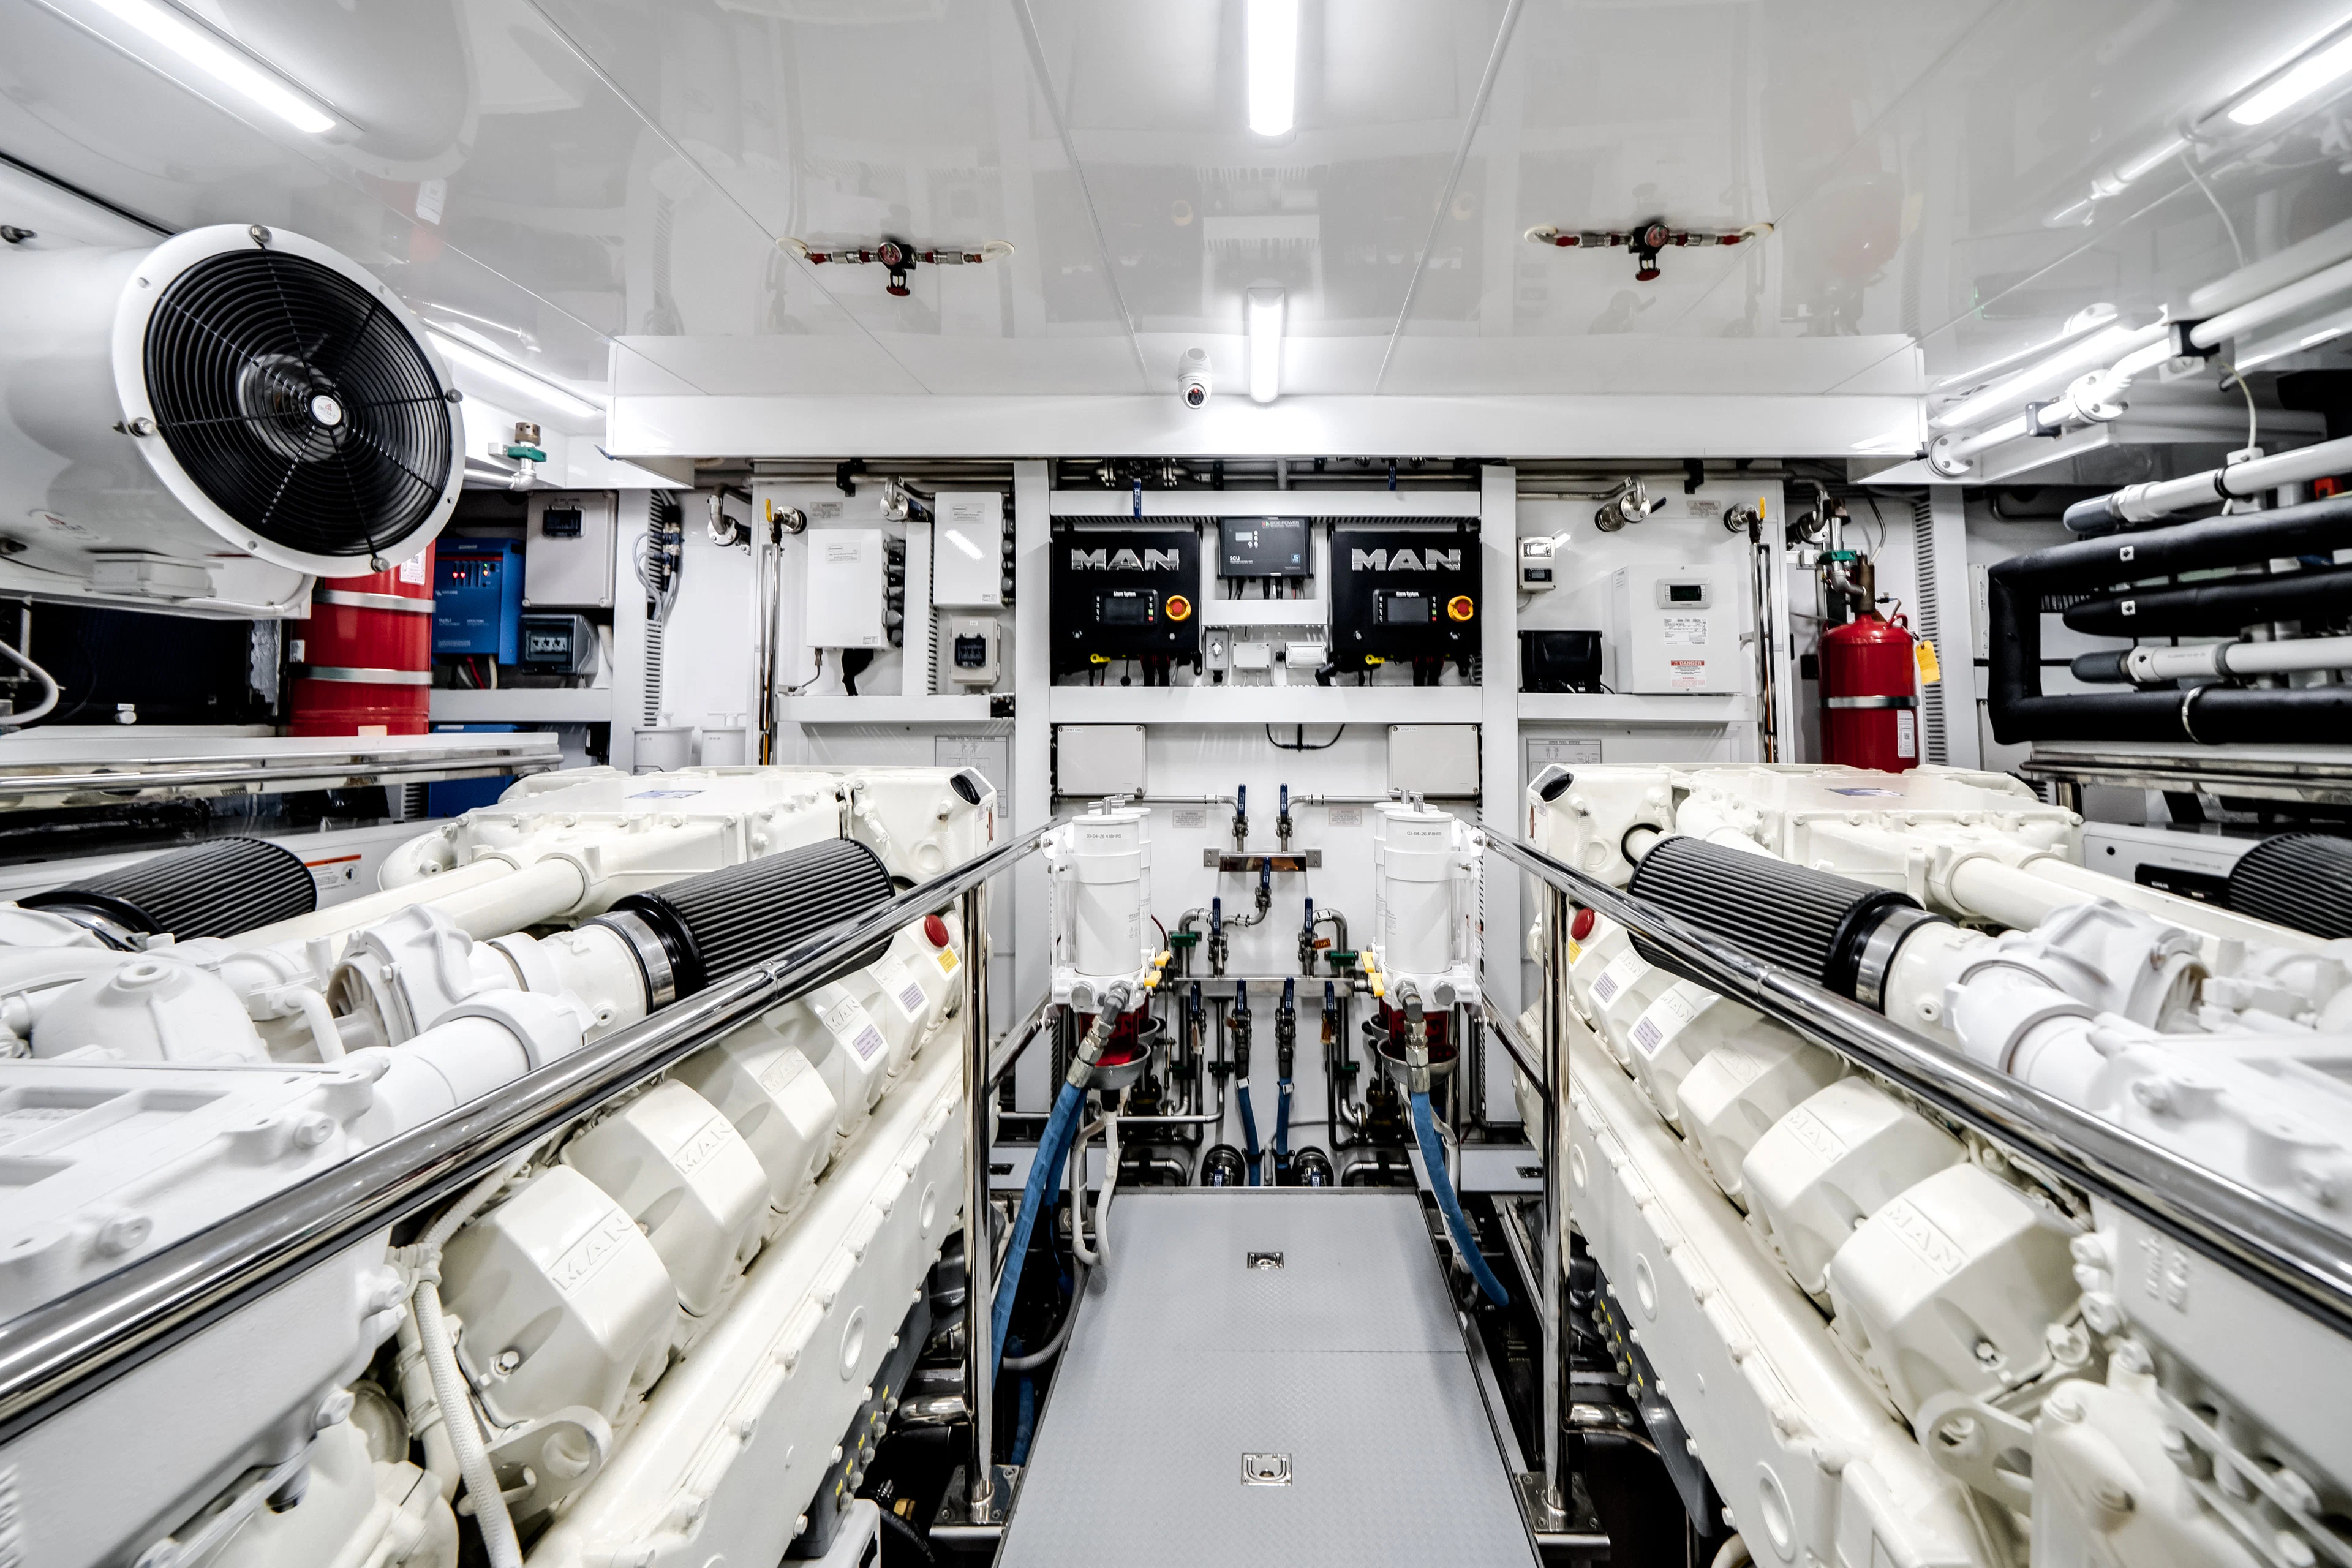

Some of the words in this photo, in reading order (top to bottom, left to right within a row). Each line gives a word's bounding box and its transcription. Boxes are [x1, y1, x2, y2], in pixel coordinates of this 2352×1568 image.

[1071, 548, 1180, 571] MAN
[1351, 549, 1461, 572] MAN
[1659, 993, 1695, 1023] MAN
[762, 1049, 806, 1093] MAN
[675, 1118, 734, 1175] MAN
[1784, 1107, 1845, 1164] MAN
[552, 1211, 638, 1292] MAN
[1882, 1199, 1964, 1277] MAN
